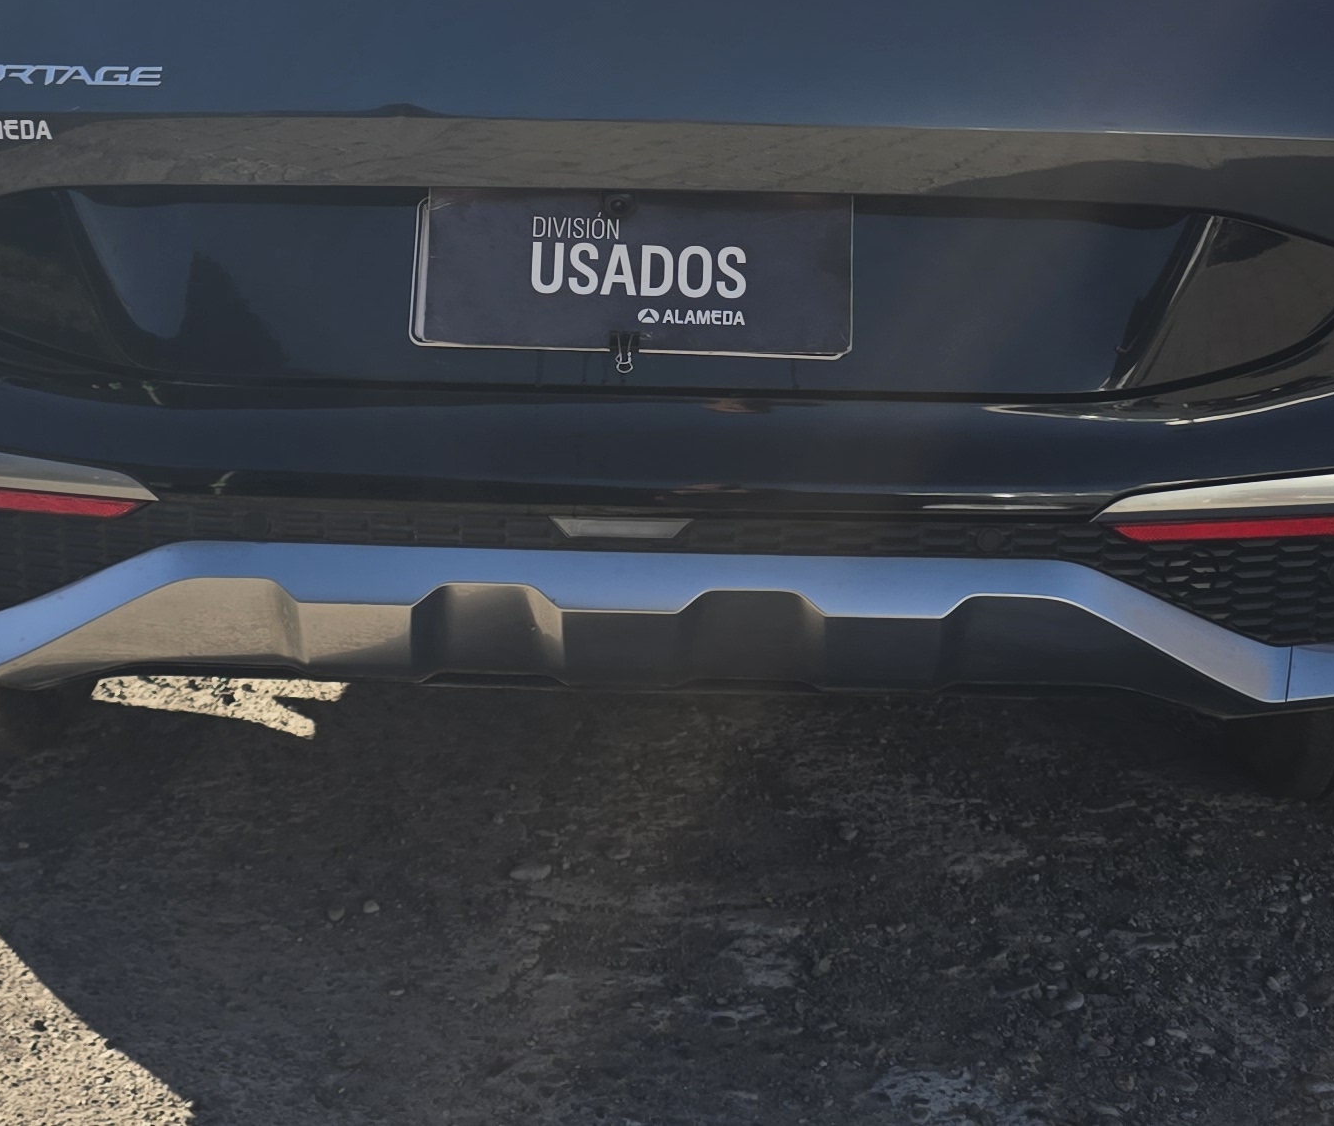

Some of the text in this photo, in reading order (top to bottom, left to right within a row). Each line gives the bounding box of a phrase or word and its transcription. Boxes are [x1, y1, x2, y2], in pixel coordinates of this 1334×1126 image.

[532, 212, 620, 240] DIVISIÓN
[531, 241, 747, 299] USADOS
[662, 309, 746, 326] ALAMEDA
